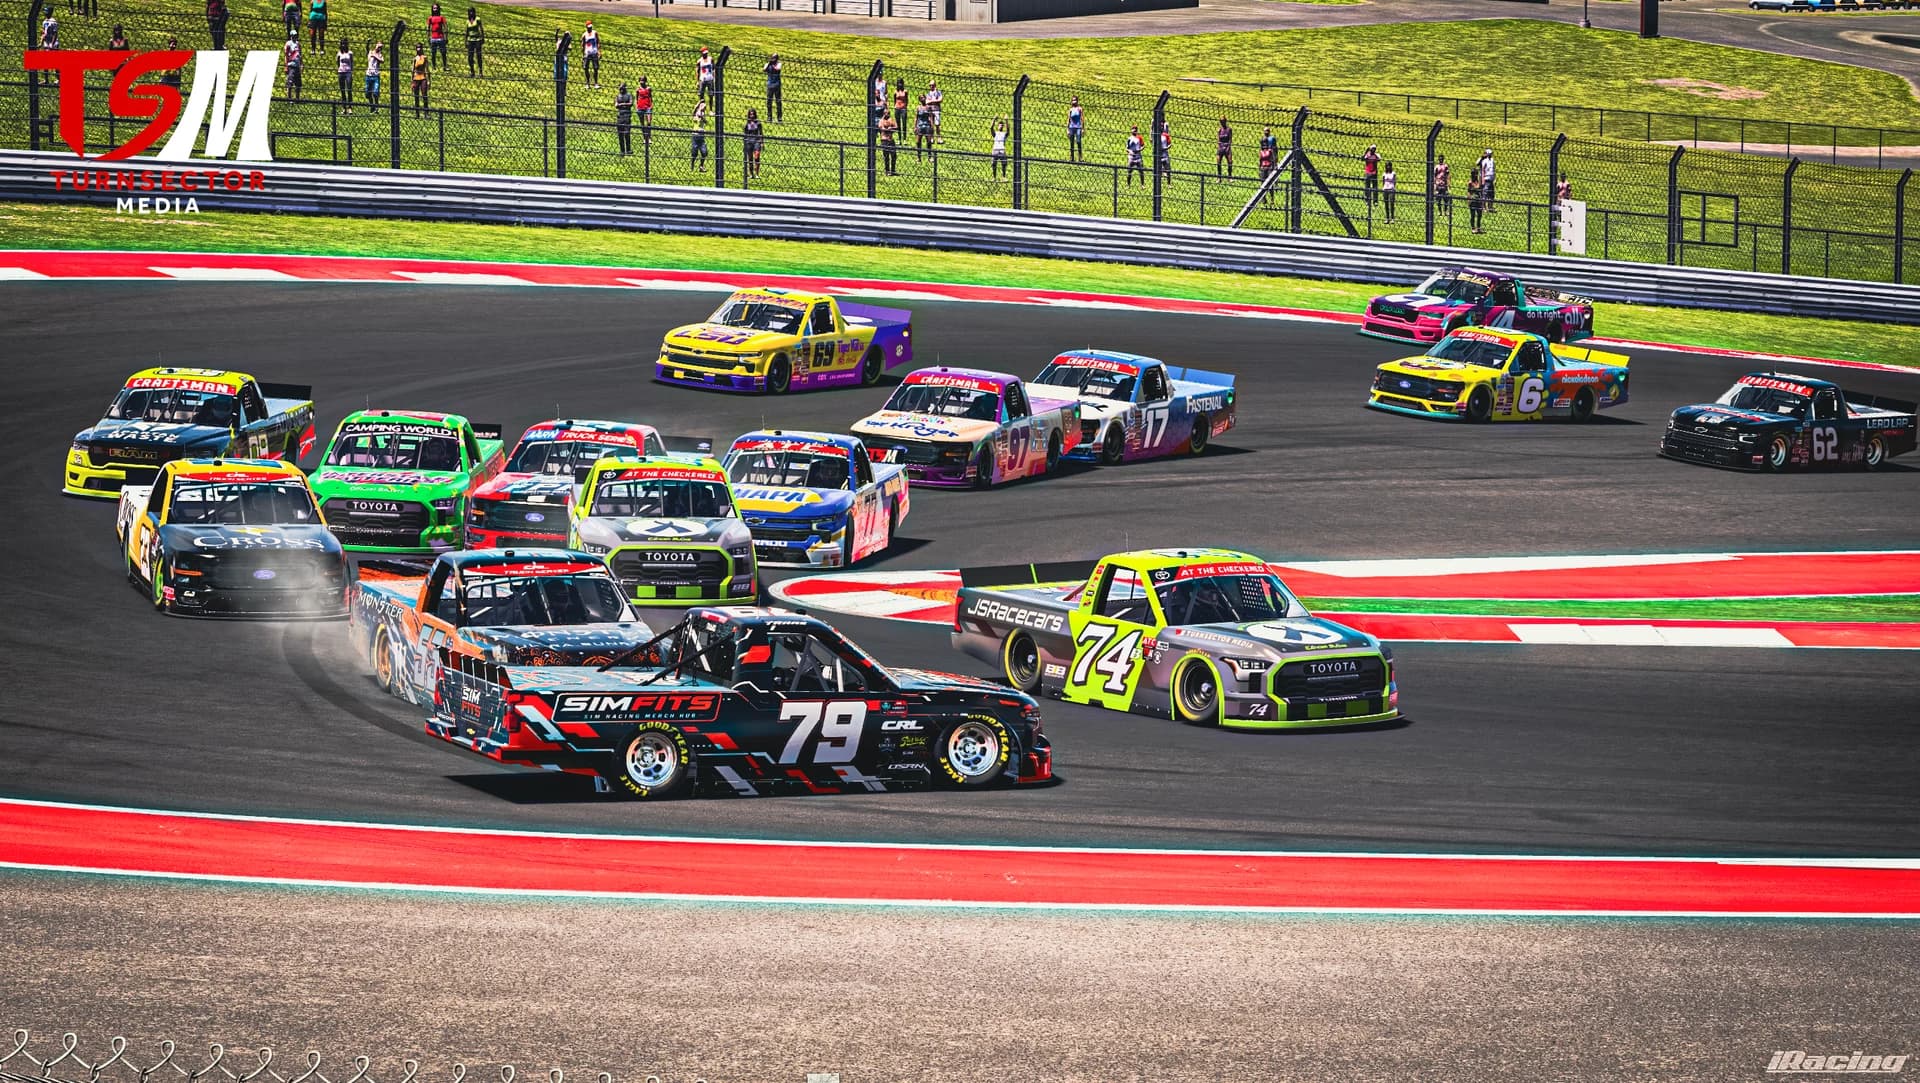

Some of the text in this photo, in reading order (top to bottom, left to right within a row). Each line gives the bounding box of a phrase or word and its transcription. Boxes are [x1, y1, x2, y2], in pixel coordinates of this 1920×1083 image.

[1564, 308, 1586, 329] ally
[1458, 331, 1501, 344] CRAFTSMAN
[812, 341, 835, 367] 69
[1066, 357, 1120, 370] CRAFTSMAN
[132, 378, 229, 393] CRAFTSMAN
[920, 376, 979, 389] CRAFTSMAN
[1743, 376, 1807, 393] CRAFTSMAN
[1518, 378, 1544, 413] 6
[1186, 395, 1223, 414] FASTENAL
[345, 424, 452, 436] CAMPING WORLD
[1143, 409, 1169, 448] 17
[1007, 426, 1029, 470] 97
[1813, 427, 1838, 460] 62
[625, 470, 716, 479] AT THE CHECKERED
[353, 501, 398, 511] TOYOTA
[646, 552, 695, 561] TOYOTA
[1197, 567, 1216, 575] THE
[1217, 565, 1265, 574] CHECKERED
[967, 599, 1064, 632] JSRacecars
[1231, 639, 1254, 649] MEDIA
[1073, 622, 1143, 693] 74
[1311, 661, 1356, 673] TOYOTA
[462, 686, 481, 704] SIM
[462, 701, 481, 717] FITS
[561, 696, 715, 711] SIMFITS
[1249, 704, 1267, 716] 74
[778, 701, 867, 764] 79
[881, 720, 924, 730] CRL
[620, 775, 648, 797] EAGLE
